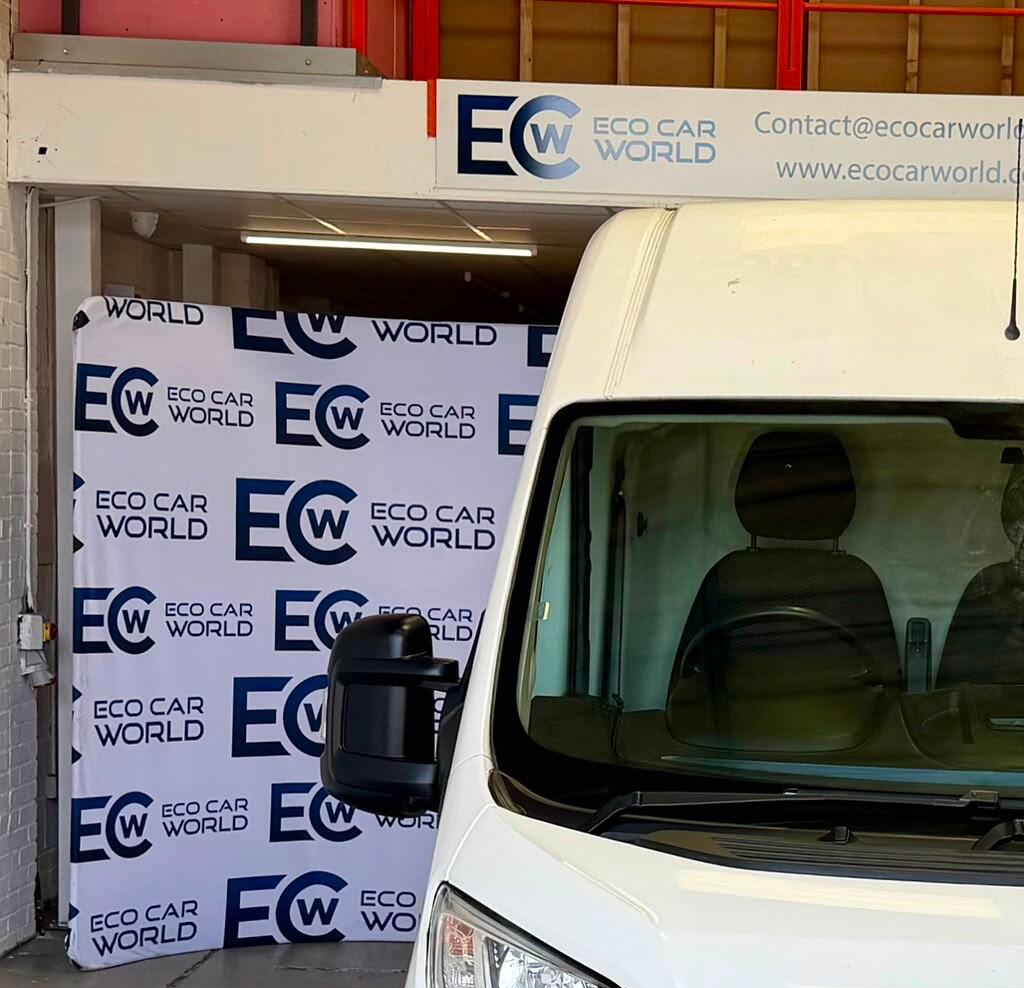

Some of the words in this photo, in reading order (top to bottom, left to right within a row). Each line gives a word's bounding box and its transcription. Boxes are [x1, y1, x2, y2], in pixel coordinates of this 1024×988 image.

[593, 117, 649, 136] ECO
[657, 119, 716, 138] CAR
[593, 139, 717, 164] WORLD
[104, 298, 203, 325] WORLD
[371, 320, 497, 346] WORLD
[168, 387, 205, 403] ECO
[211, 391, 253, 407] CAR
[169, 405, 253, 427] WORLD
[381, 403, 423, 417] ECO
[430, 405, 474, 419] CAR
[381, 420, 475, 439] WORLD
[96, 491, 146, 510] ECO
[154, 493, 207, 513] CAR
[371, 503, 427, 521] ECO
[436, 506, 494, 524] CAR
[97, 515, 207, 539] WORLD
[372, 525, 495, 550] WORLD
[166, 603, 204, 616] ECO
[210, 603, 252, 616] CAR
[427, 607, 473, 622] CAR
[166, 621, 253, 637] WORLD
[94, 699, 143, 719] ECO
[150, 697, 203, 715] CAR
[95, 720, 204, 746] WORLD
[162, 802, 200, 817] ECO
[206, 798, 248, 813] CAR
[163, 815, 248, 837] WORLD
[361, 891, 416, 907] ECO
[91, 909, 138, 933] ECO
[145, 900, 198, 922] CAR
[92, 921, 197, 957] WORLD
